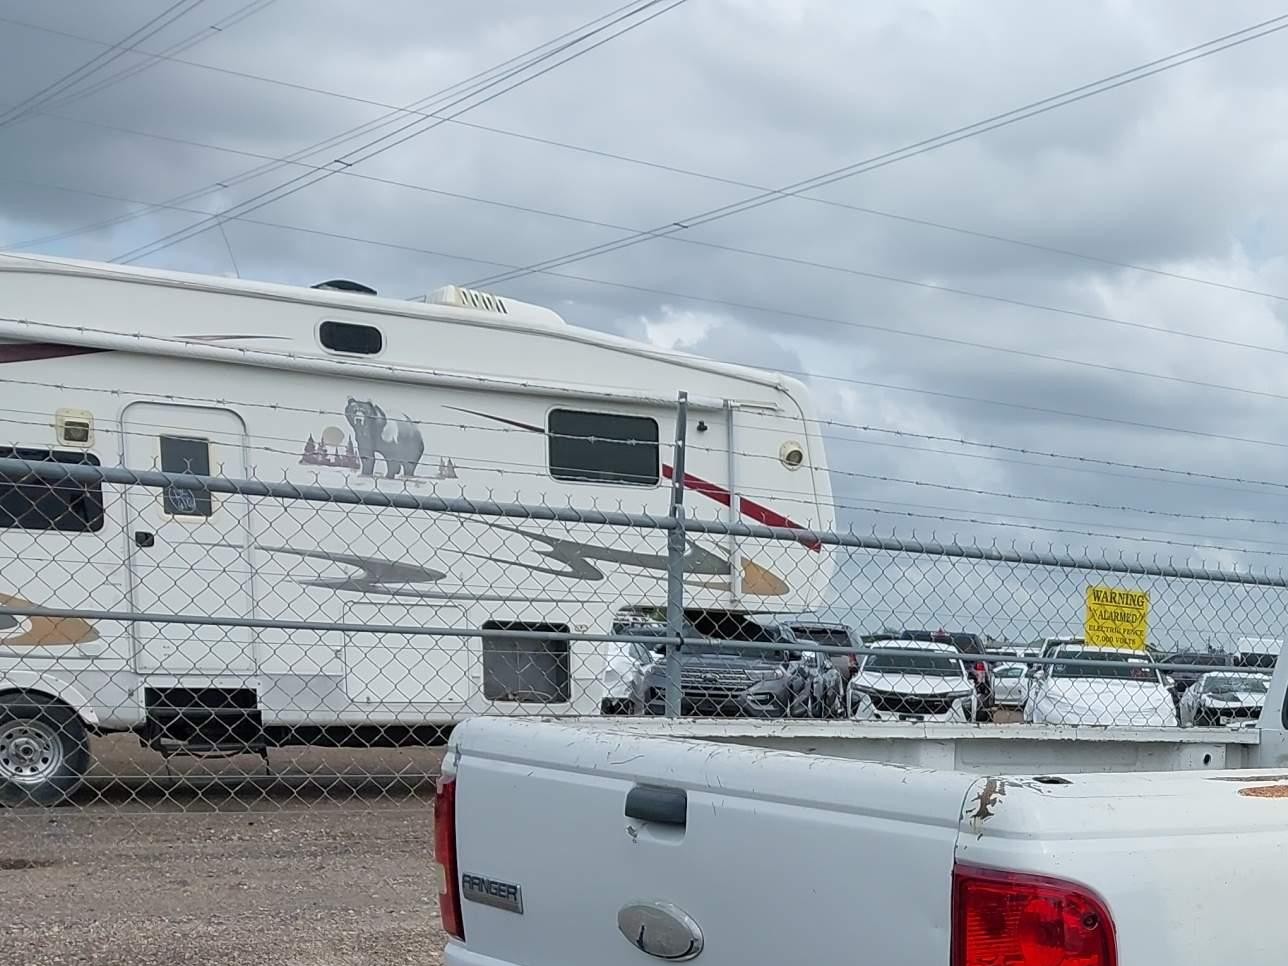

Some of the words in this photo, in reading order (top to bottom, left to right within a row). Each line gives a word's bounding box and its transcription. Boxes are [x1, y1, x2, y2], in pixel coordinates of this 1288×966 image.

[1092, 589, 1145, 607] WARNING
[1097, 609, 1137, 624] ALARMED
[1095, 634, 1114, 643] 7,000
[1115, 636, 1136, 646] VOLTS
[462, 873, 518, 902] RANGER
